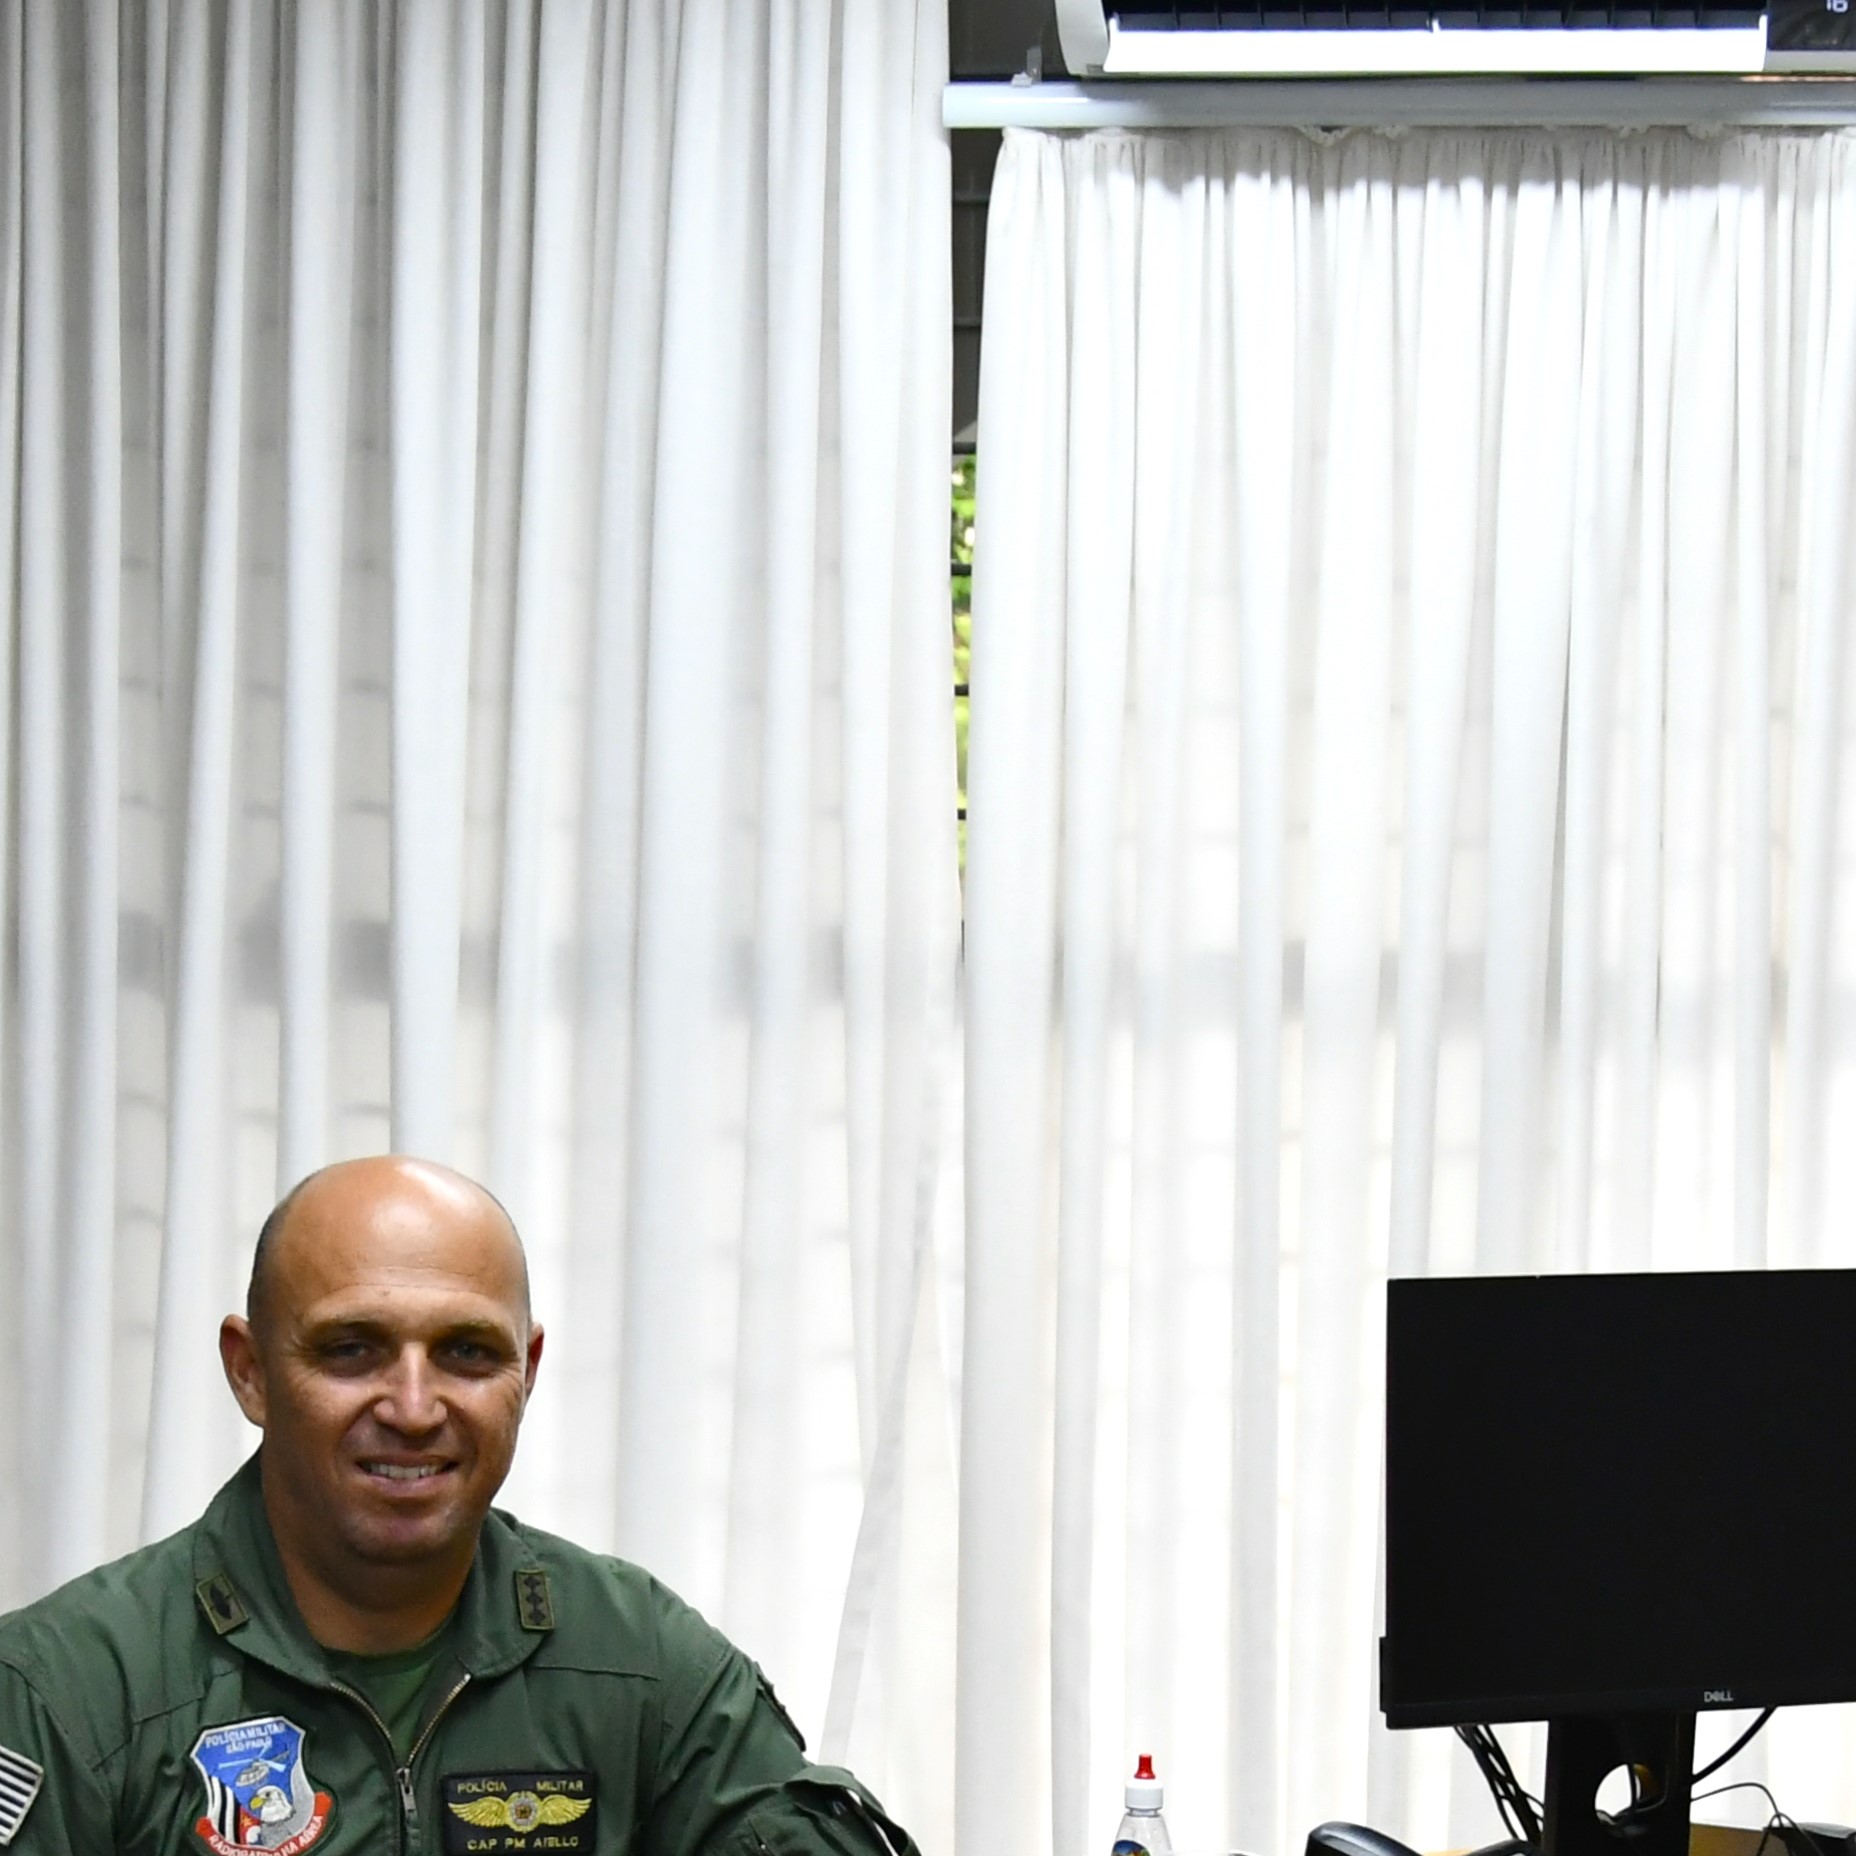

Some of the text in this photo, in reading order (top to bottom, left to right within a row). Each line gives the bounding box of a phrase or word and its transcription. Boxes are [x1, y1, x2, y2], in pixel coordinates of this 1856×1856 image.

[1704, 1690, 1734, 1702] DELL
[206, 1723, 285, 1748] POLÍCIA MILITAR
[457, 1780, 584, 1794] POLÍCIA MILITAR
[467, 1836, 579, 1851] CAP PM AIELLO
